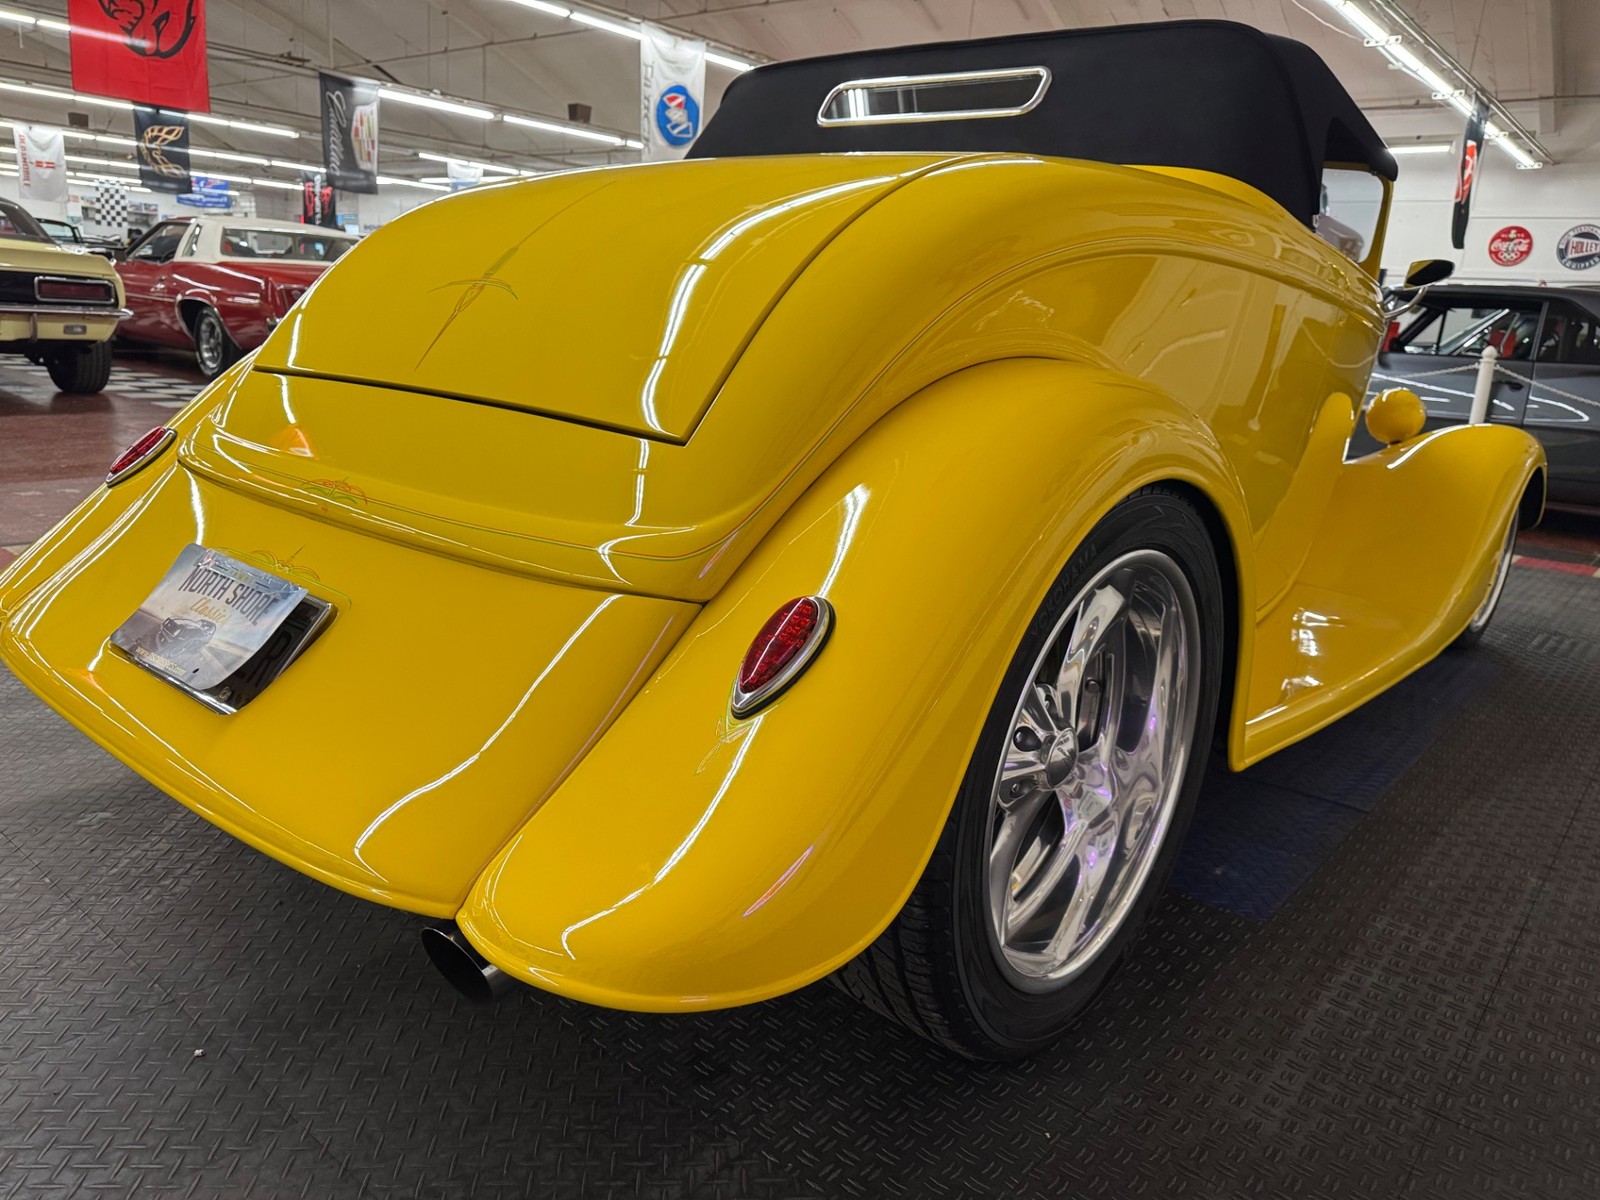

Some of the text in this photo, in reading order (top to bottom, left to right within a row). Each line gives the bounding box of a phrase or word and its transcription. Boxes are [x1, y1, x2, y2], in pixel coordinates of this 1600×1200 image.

[326, 90, 347, 176] Cadillac
[1570, 240, 1598, 256] HOLLEY
[178, 564, 280, 626] NORTH SHORE
[1029, 543, 1098, 637] YOKOHAMA
